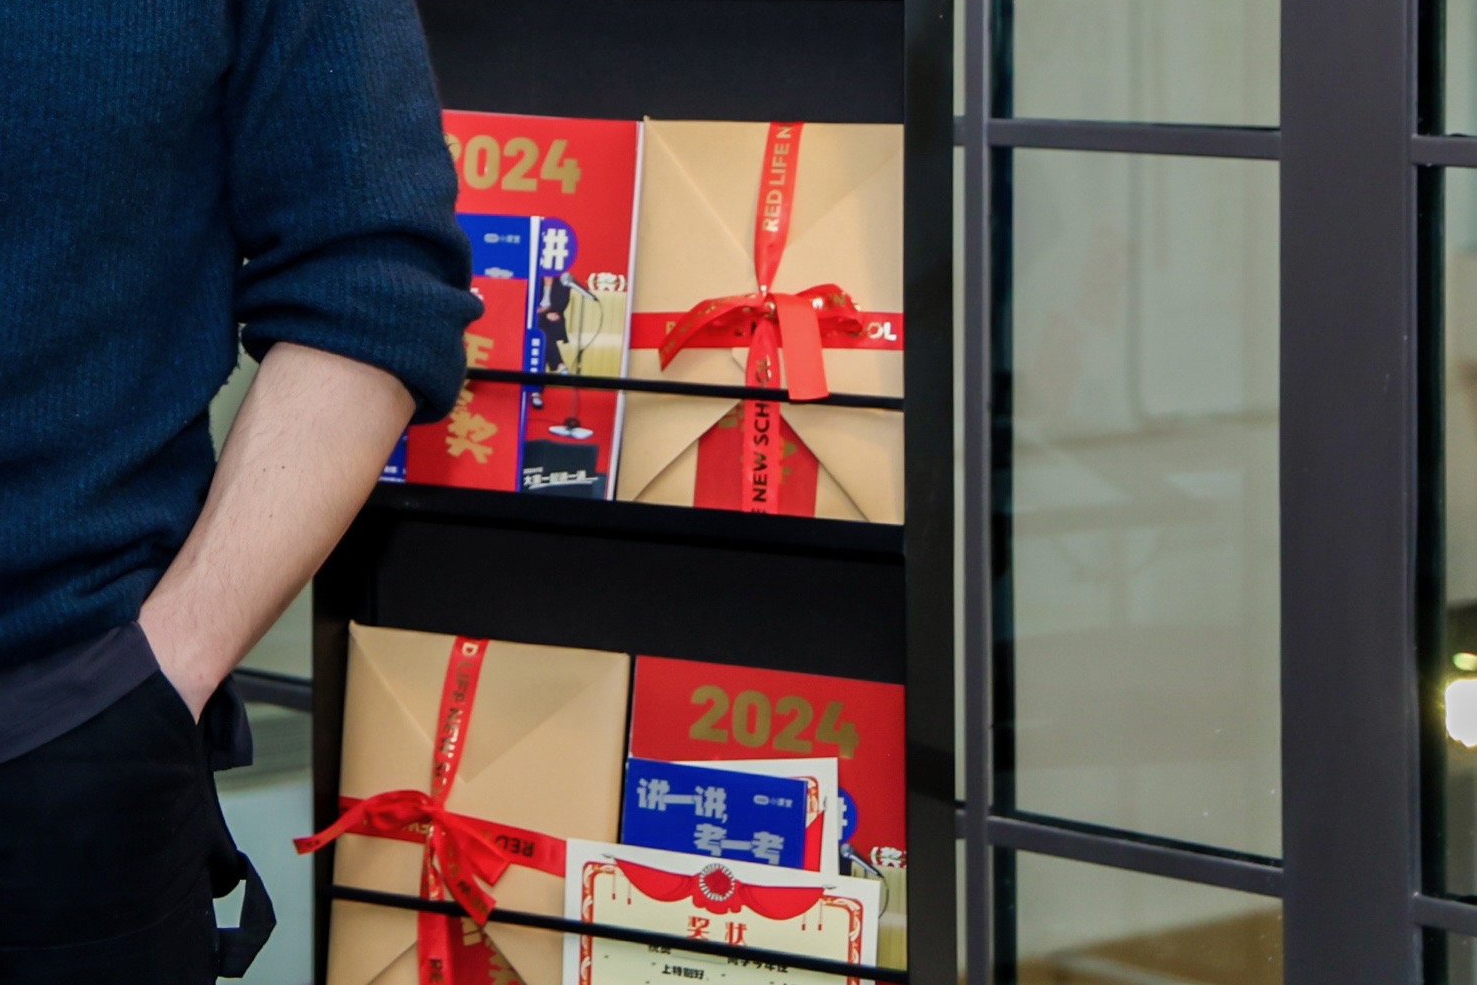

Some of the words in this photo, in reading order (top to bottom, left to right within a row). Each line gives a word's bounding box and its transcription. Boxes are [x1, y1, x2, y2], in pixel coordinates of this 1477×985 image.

[770, 143, 791, 187] LIFE
[762, 191, 782, 233] RED
[753, 354, 772, 446] SCHOL
[752, 452, 768, 503] NEW
[689, 684, 860, 759] 2024
[693, 823, 785, 865] 考一考
[686, 916, 748, 946] 奖状
[662, 964, 706, 980] 上特别好
